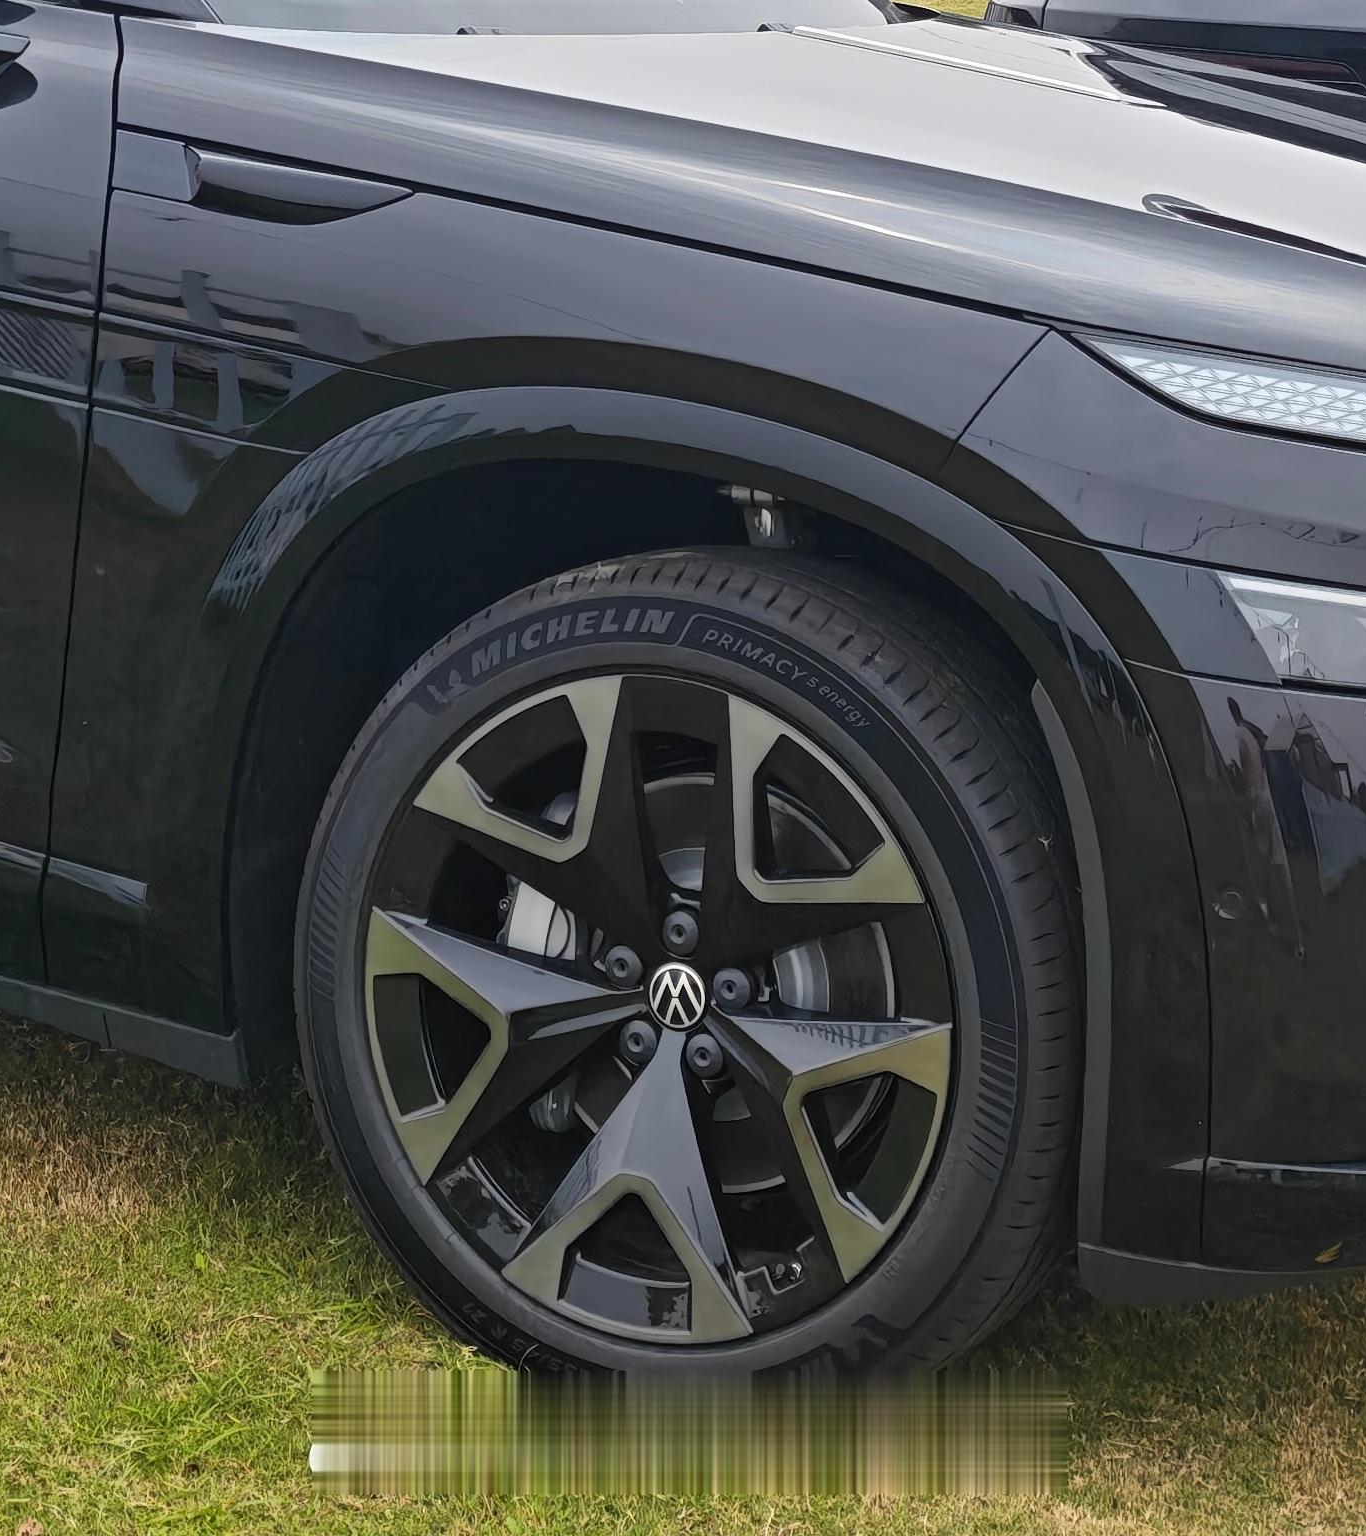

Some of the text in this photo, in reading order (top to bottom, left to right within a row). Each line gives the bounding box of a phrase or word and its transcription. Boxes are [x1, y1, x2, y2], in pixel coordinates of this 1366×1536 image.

[471, 607, 676, 678] MICHELIN
[702, 629, 808, 681] PRIMACY
[818, 685, 871, 728] energy
